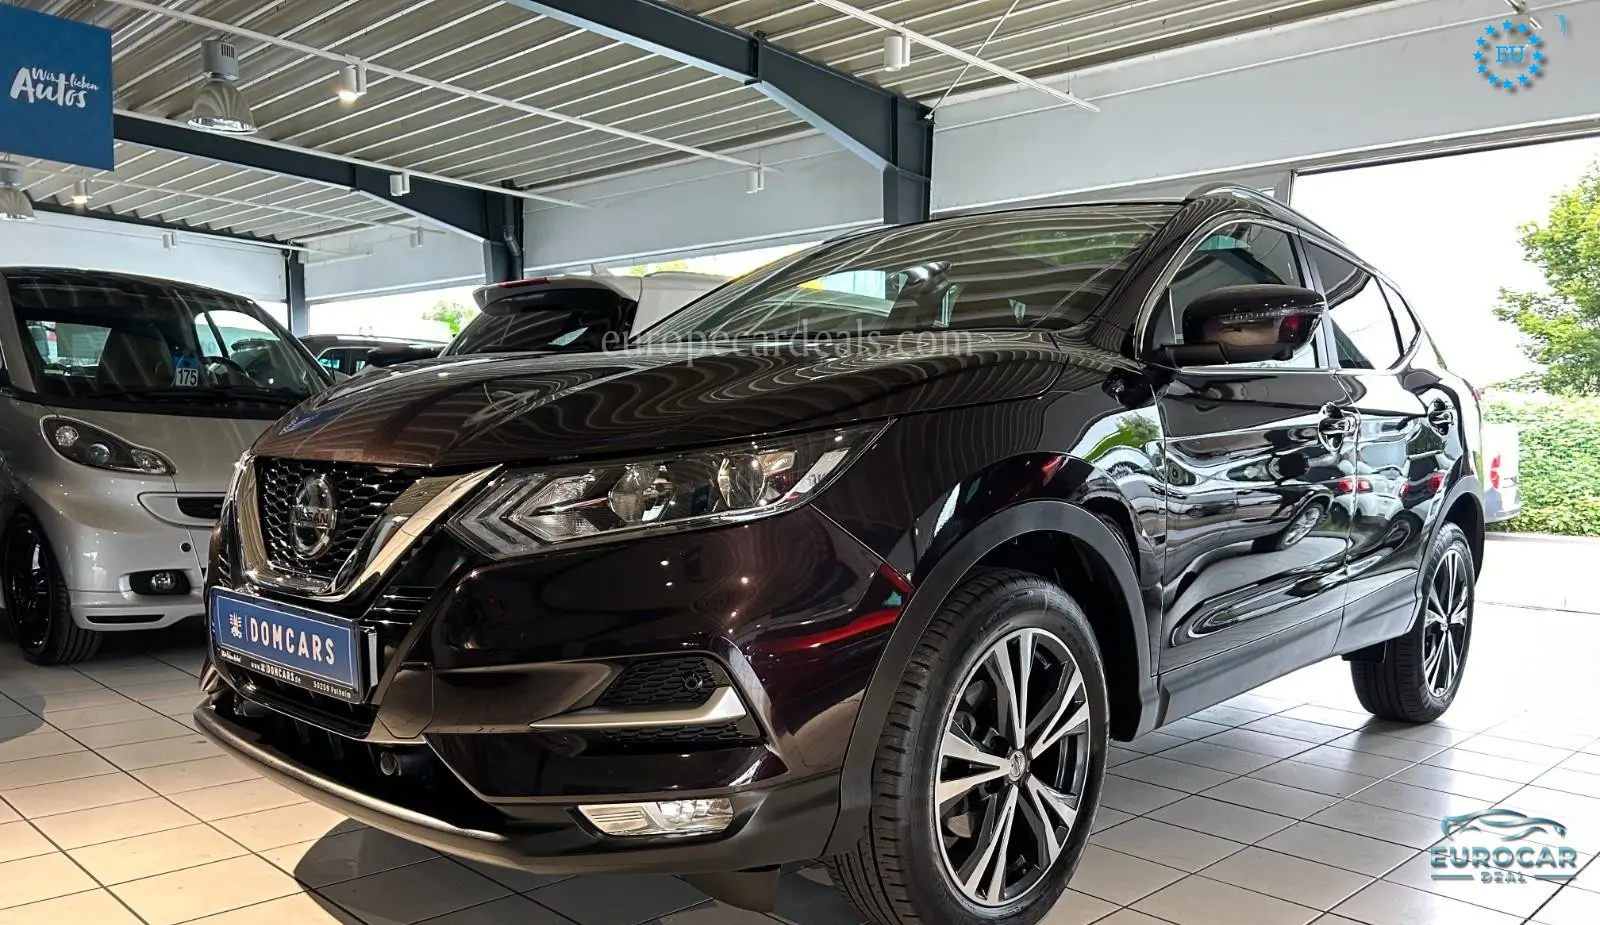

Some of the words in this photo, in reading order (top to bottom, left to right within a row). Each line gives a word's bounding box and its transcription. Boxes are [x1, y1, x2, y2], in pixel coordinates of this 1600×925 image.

[10, 67, 87, 108] Autos
[32, 67, 55, 82] Wir
[70, 73, 99, 91] lieben
[178, 369, 197, 386] 175
[250, 617, 335, 665] DOMCARS
